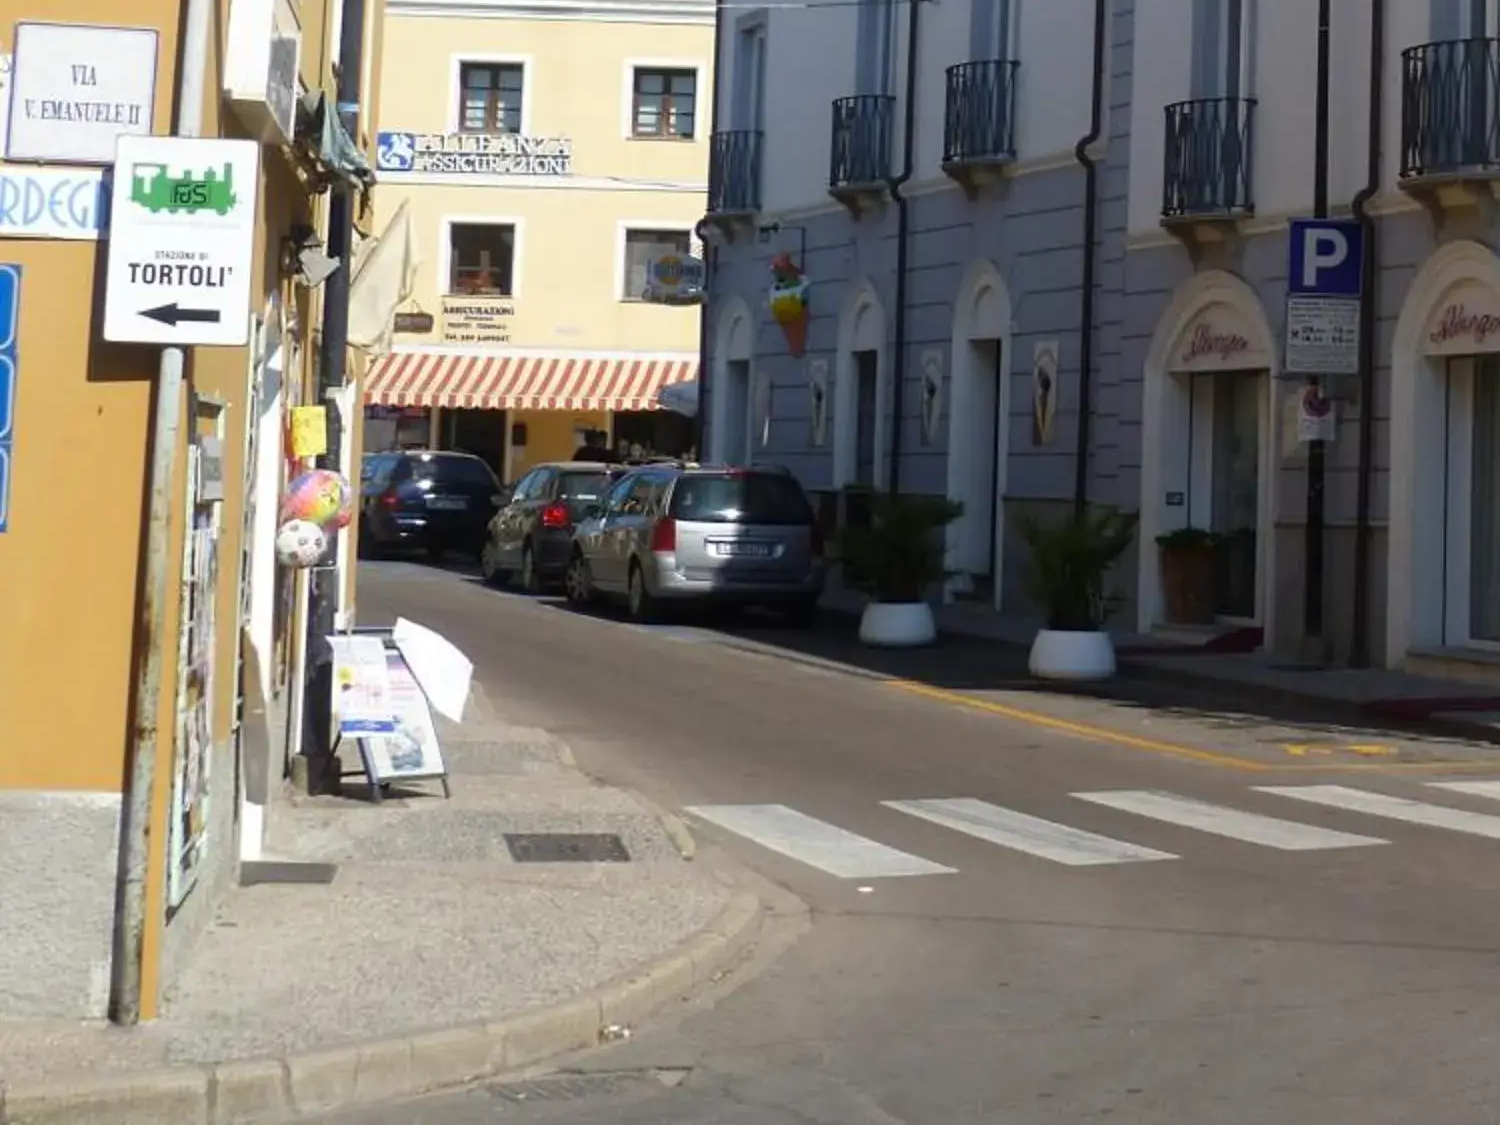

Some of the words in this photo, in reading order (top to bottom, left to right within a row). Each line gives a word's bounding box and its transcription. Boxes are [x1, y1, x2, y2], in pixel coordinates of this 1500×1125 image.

[71, 64, 97, 86] VIA
[41, 100, 123, 124] EMANUELE
[128, 104, 140, 124] II
[155, 250, 195, 260] STAZIONE
[1303, 228, 1348, 286] P
[128, 262, 233, 287] TORTOLI'
[1182, 323, 1249, 362] Albergo
